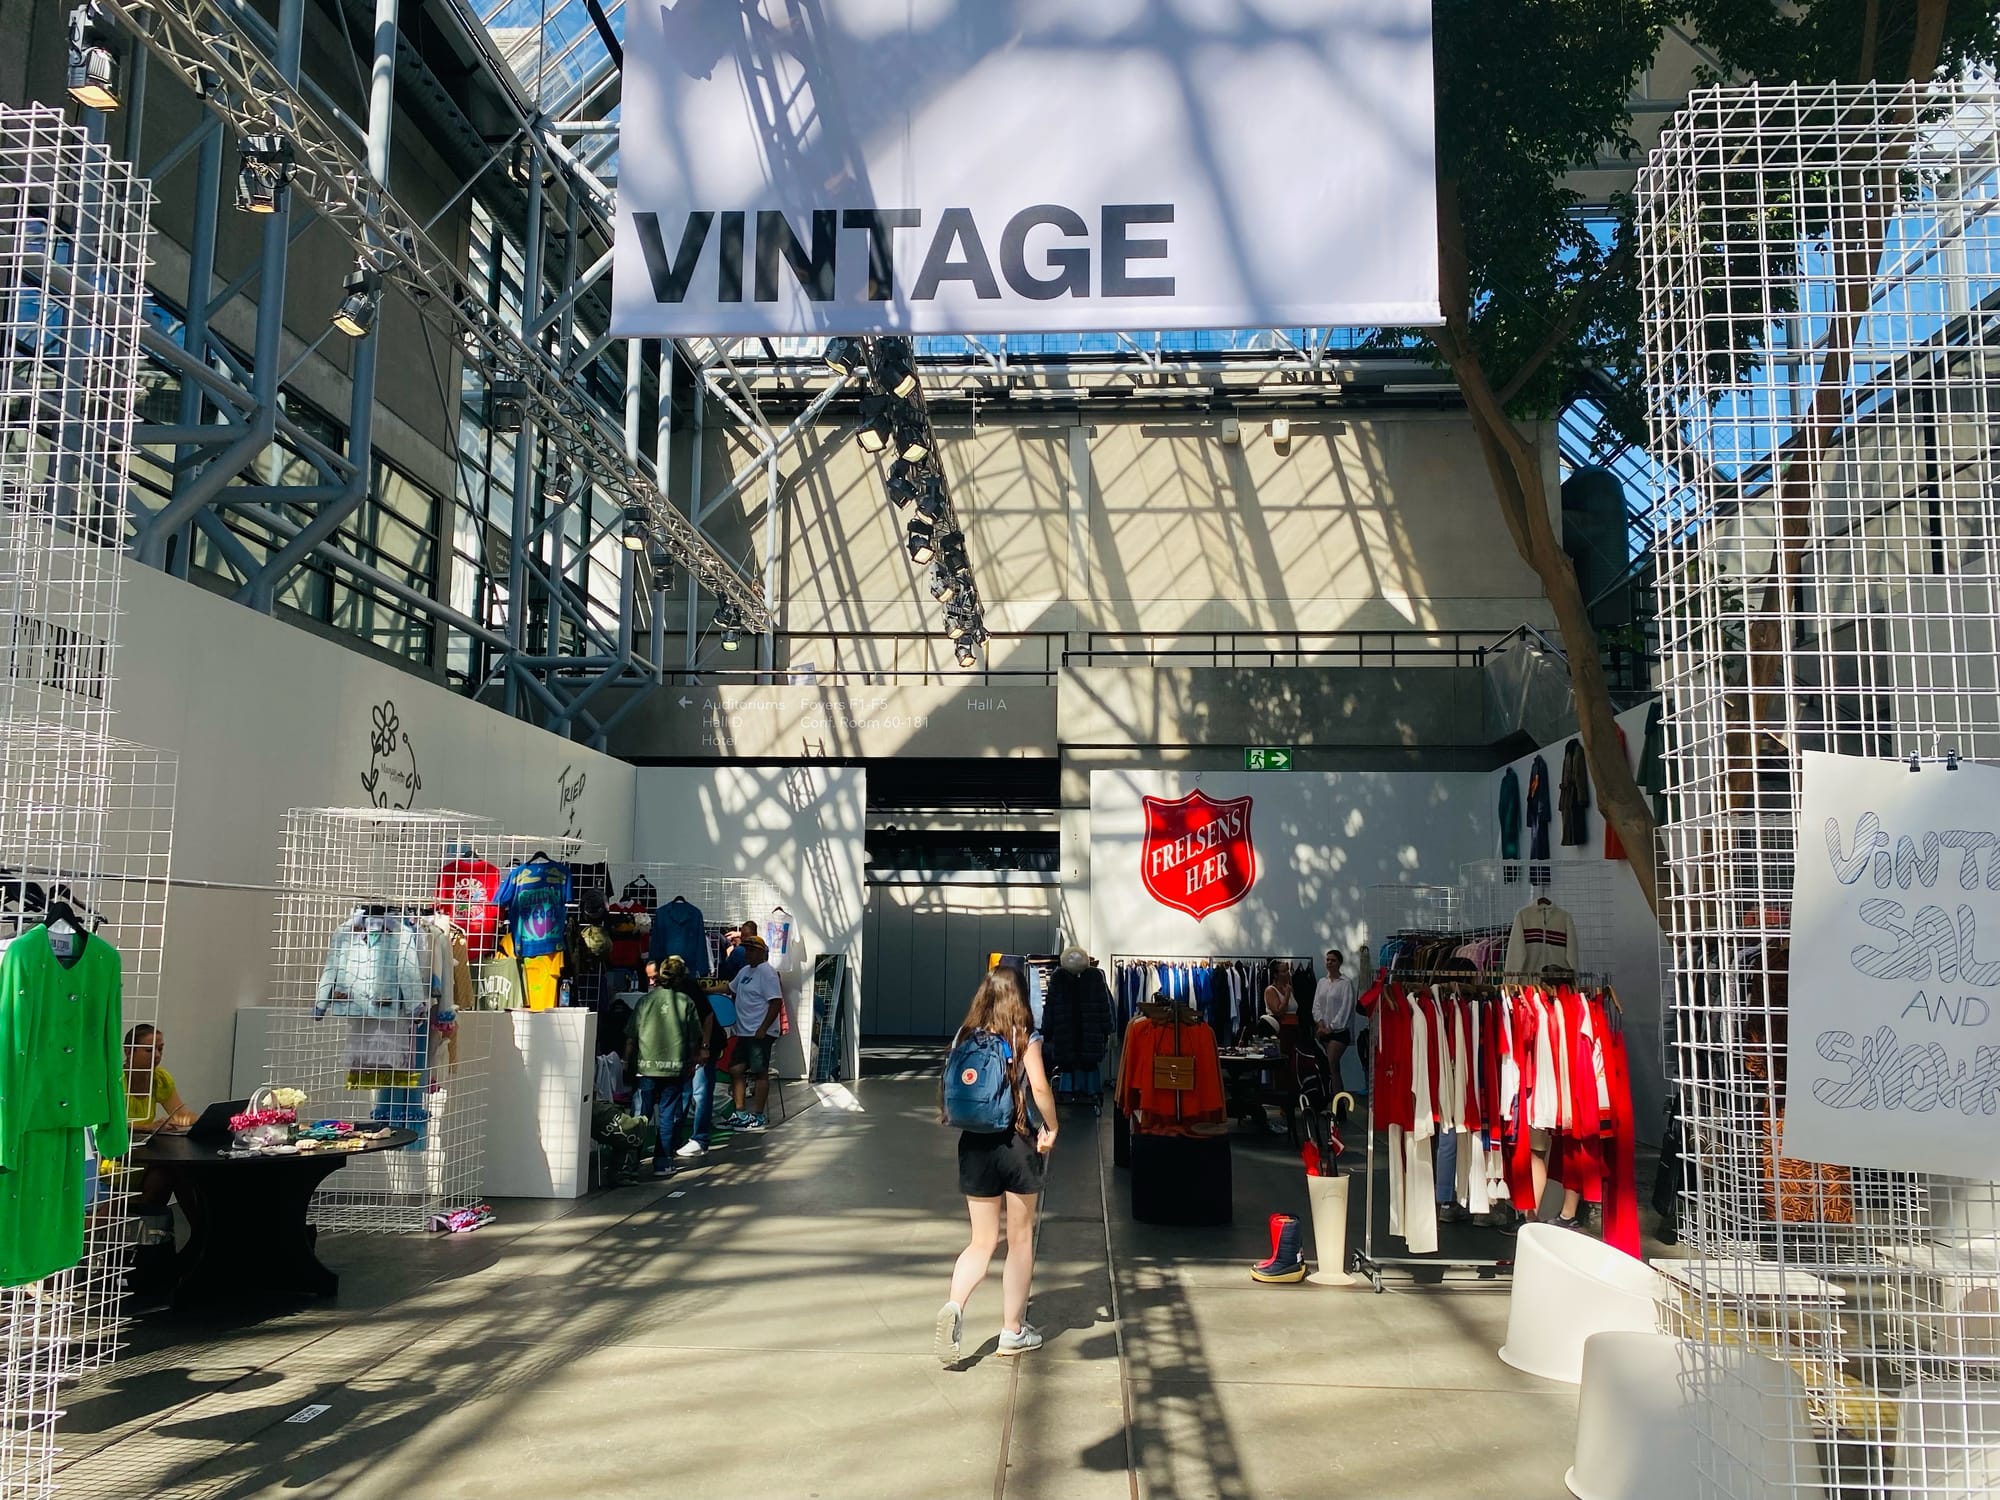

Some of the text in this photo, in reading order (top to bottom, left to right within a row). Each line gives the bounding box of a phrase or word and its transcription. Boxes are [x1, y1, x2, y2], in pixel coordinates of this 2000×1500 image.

[632, 203, 1176, 304] VINTAGE
[703, 698, 785, 711] Auditoriums
[800, 698, 846, 713] Foyers
[967, 699, 1007, 711] Hall A
[703, 716, 743, 728] Hall D
[800, 716, 929, 729] Conf. Room 60-181
[702, 735, 738, 746] Hotel
[558, 765, 586, 812] TRIED
[1151, 808, 1242, 878] FRELSENS
[1185, 852, 1229, 896] HÆR
[1901, 990, 1990, 1026] AND
